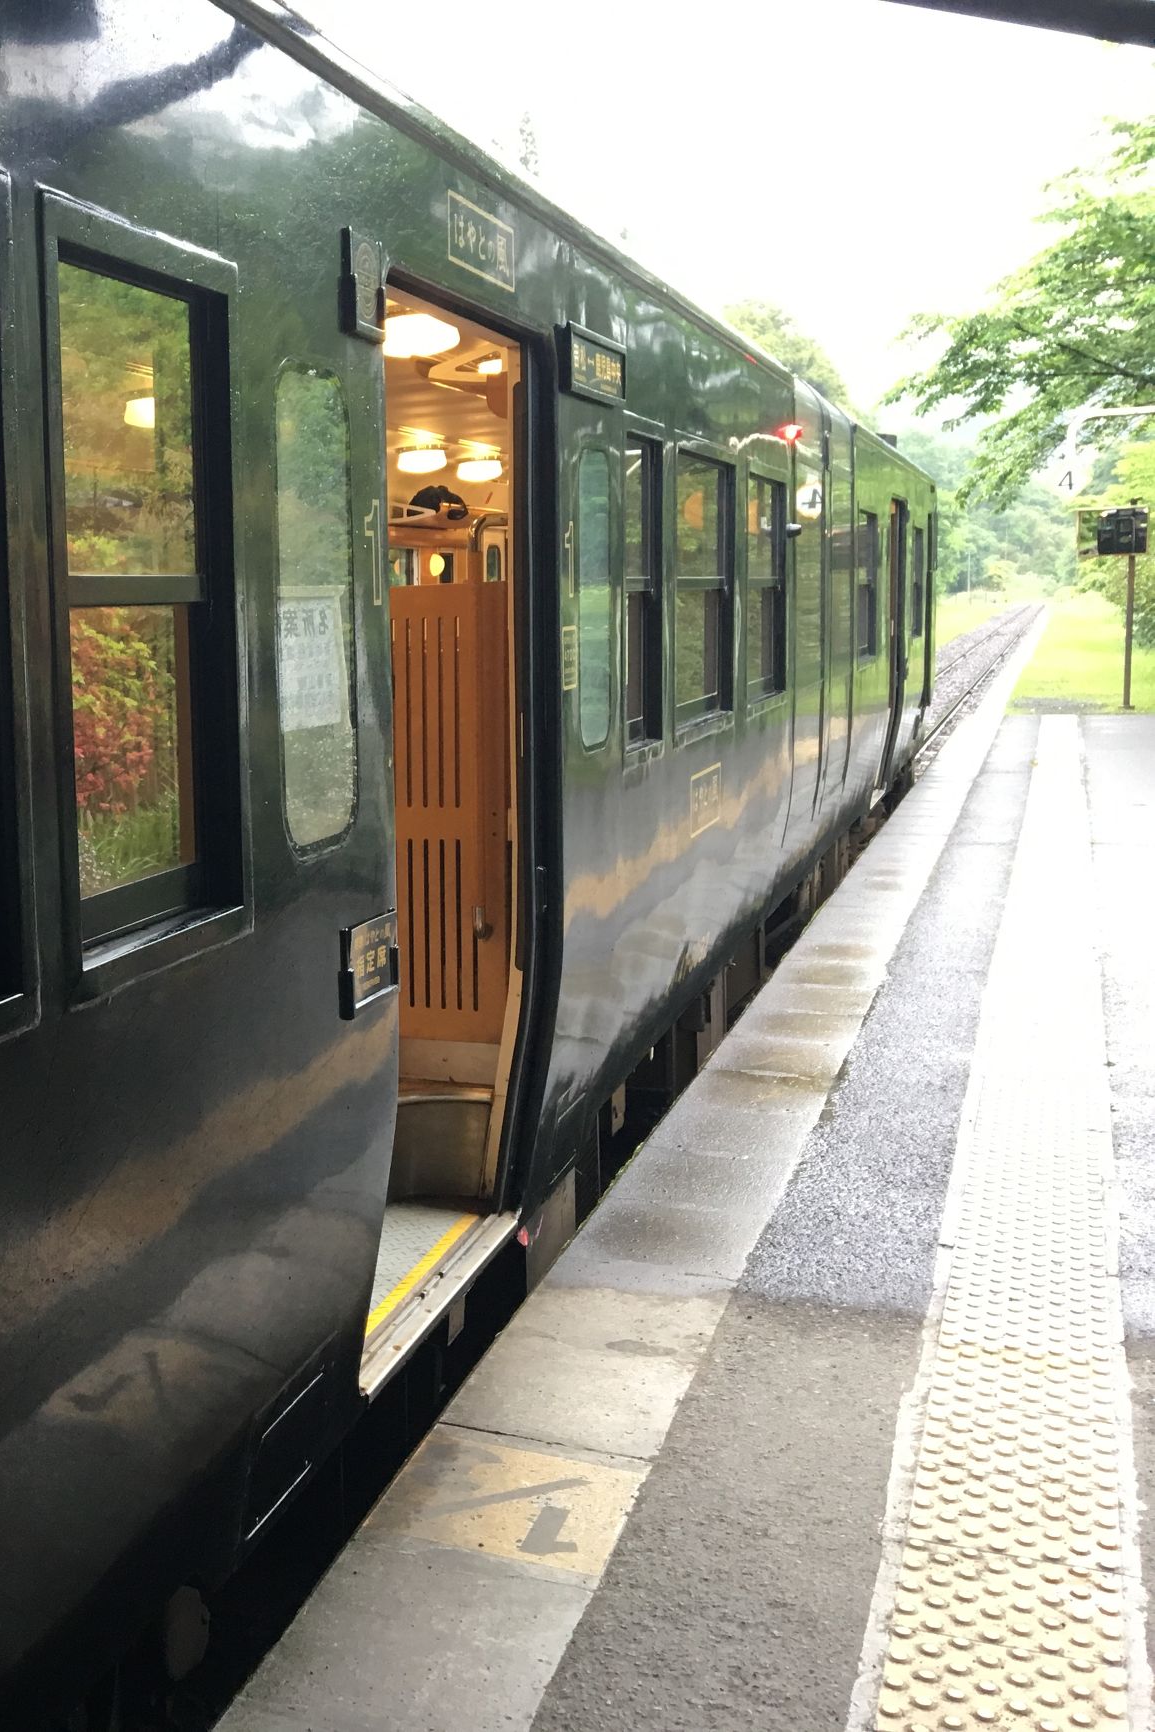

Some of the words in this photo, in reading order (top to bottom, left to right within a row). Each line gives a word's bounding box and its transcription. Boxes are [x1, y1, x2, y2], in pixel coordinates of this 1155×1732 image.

[454, 213, 510, 278] はやとの風
[1058, 471, 1073, 490] 4
[364, 499, 382, 605] 1
[564, 520, 575, 598] 1
